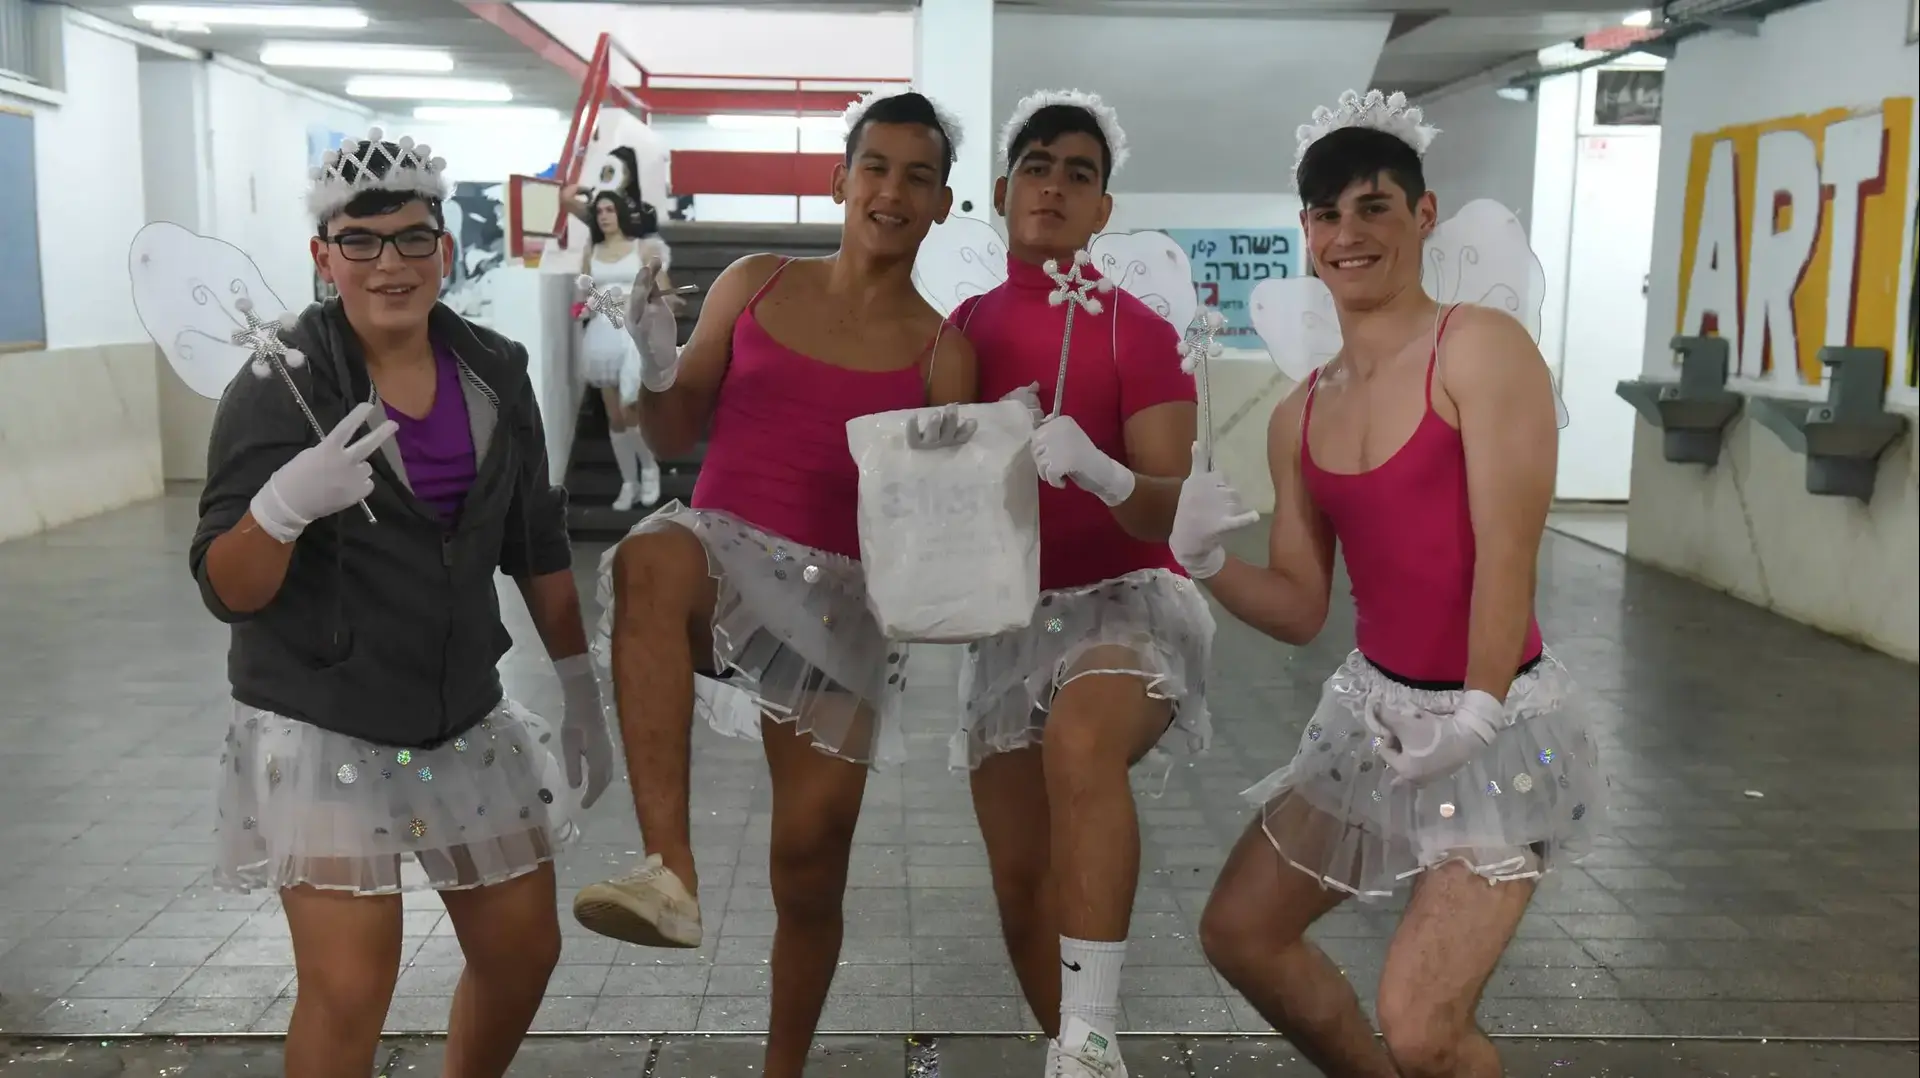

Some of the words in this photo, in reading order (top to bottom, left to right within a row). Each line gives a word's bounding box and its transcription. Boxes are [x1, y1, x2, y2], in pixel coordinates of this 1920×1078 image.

[1191, 239, 1217, 260] קטן
[1230, 234, 1289, 255] משהו
[1204, 261, 1288, 280] למטרה
